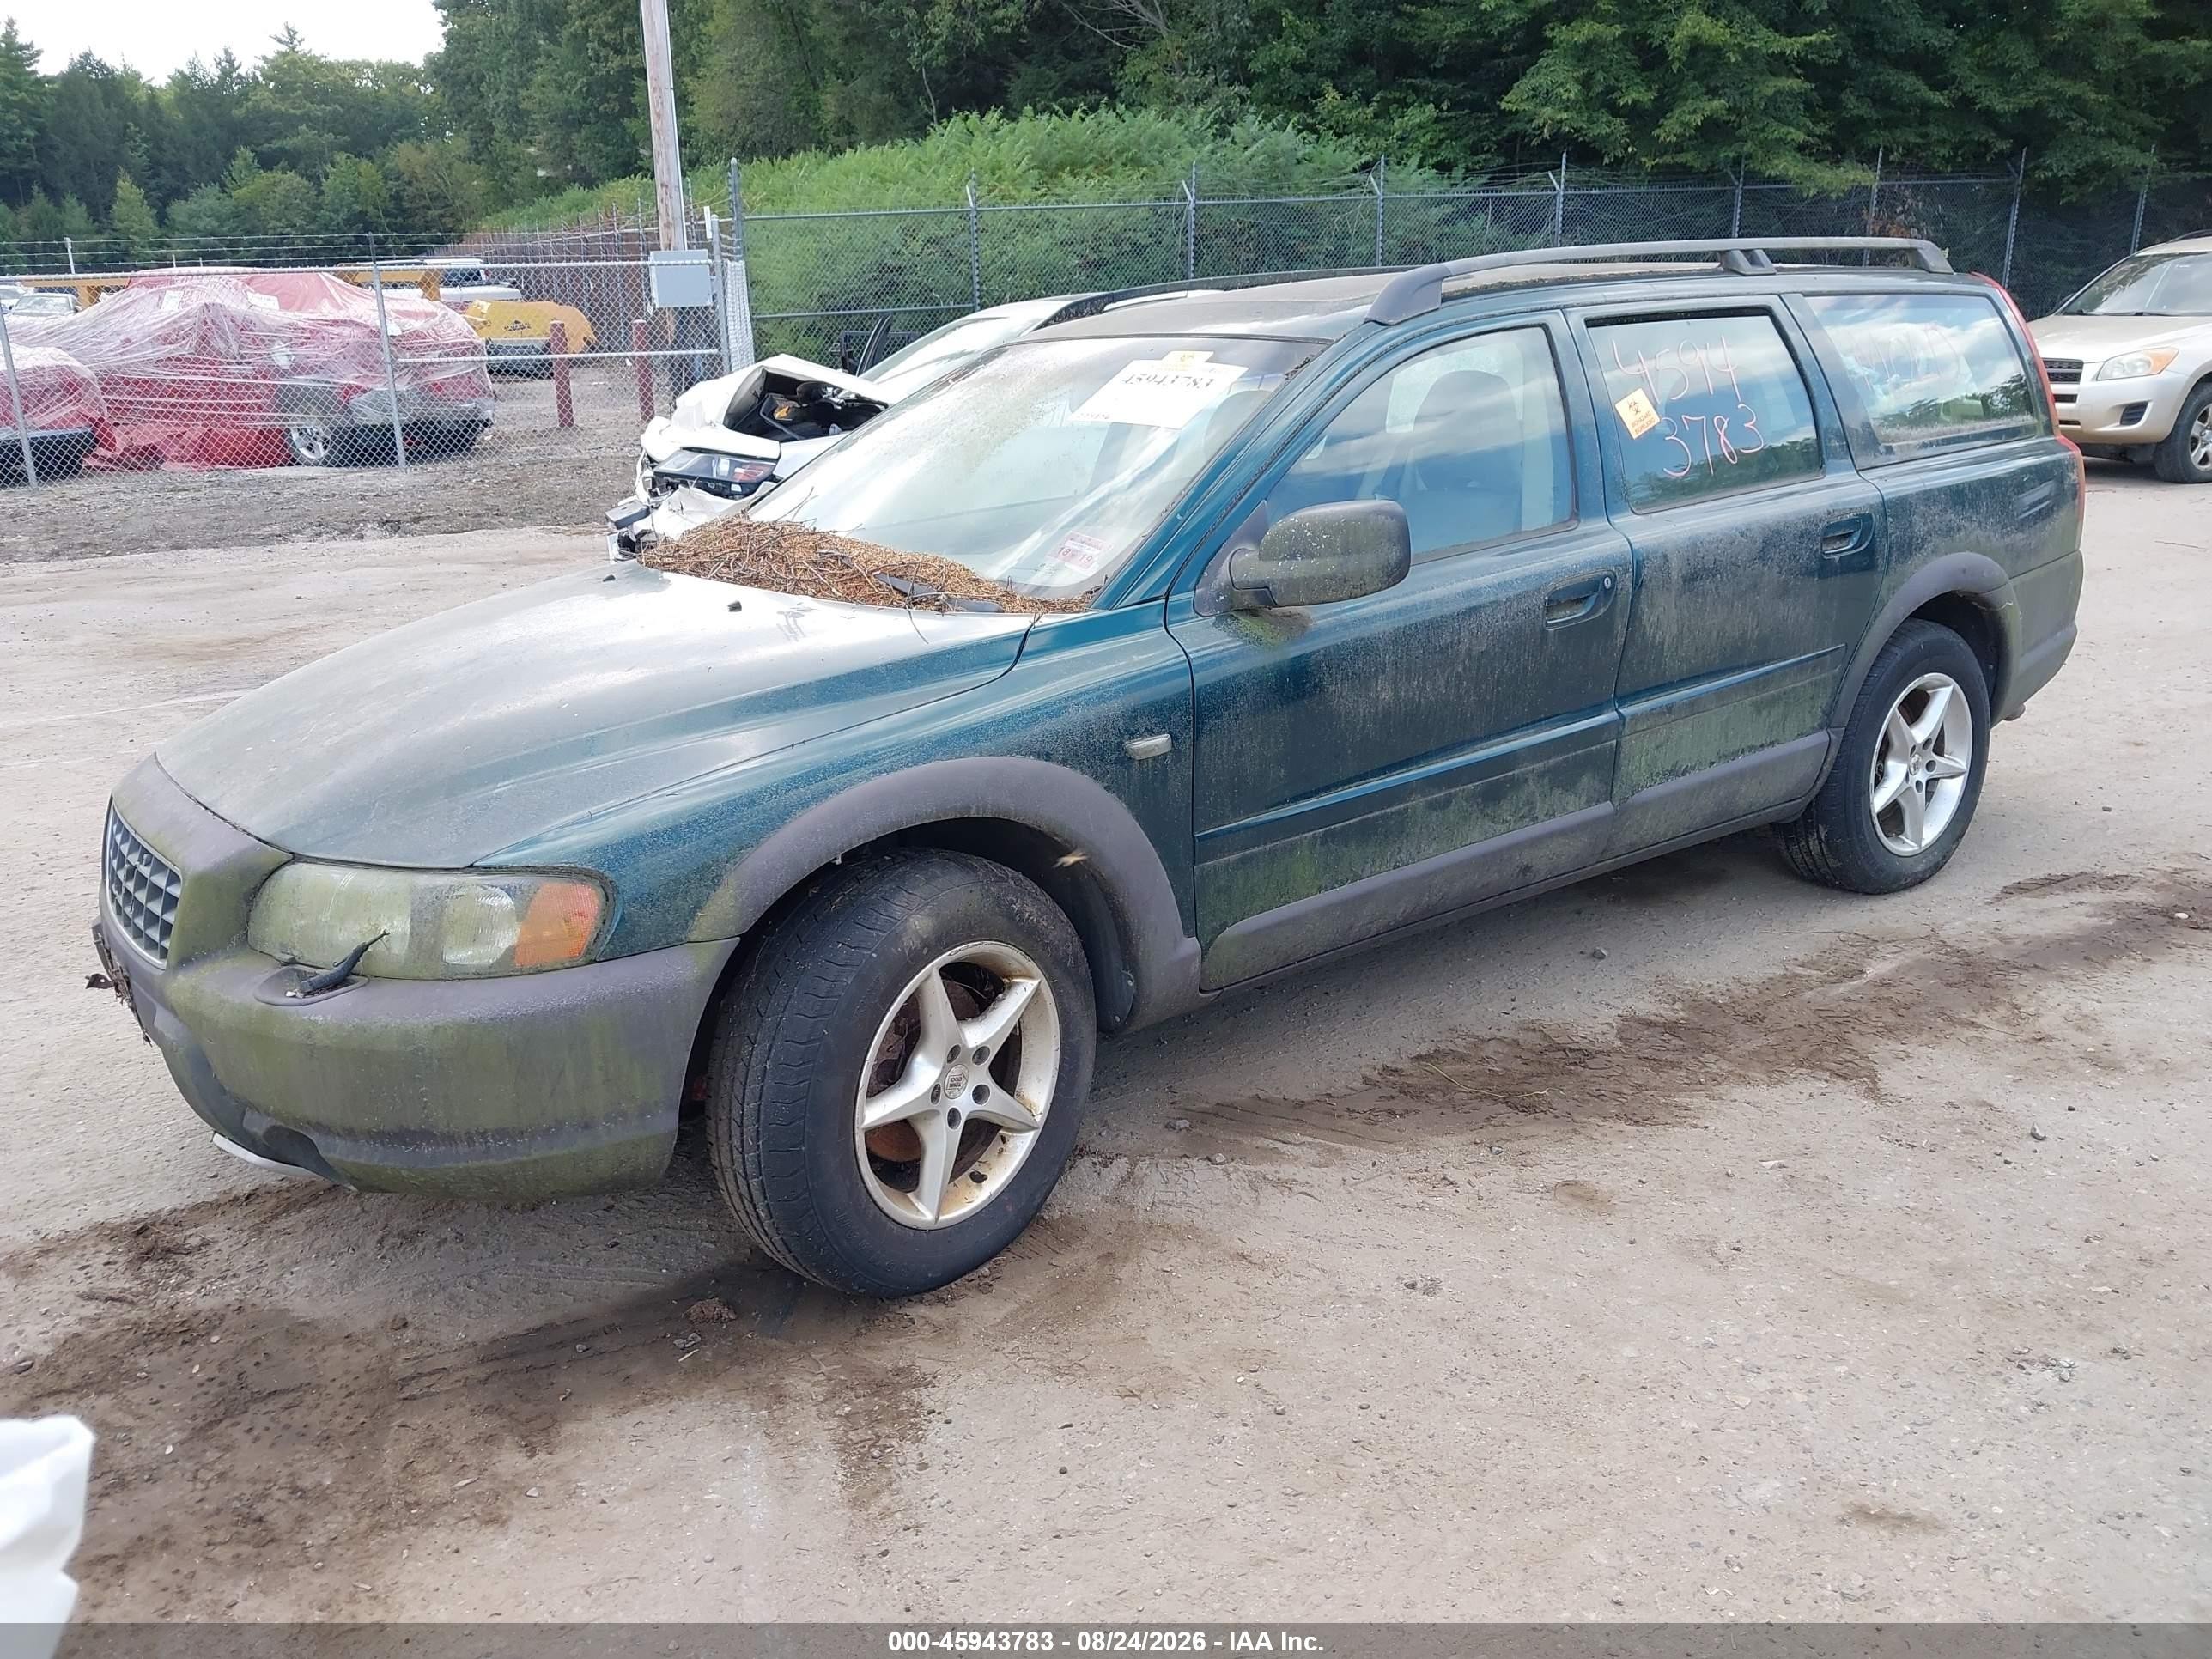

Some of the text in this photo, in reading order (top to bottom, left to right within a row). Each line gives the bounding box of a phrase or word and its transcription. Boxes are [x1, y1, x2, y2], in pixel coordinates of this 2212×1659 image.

[1612, 335, 1741, 404] 4594
[1661, 404, 1765, 477] 3783
[1058, 547, 1093, 563] 18 19
